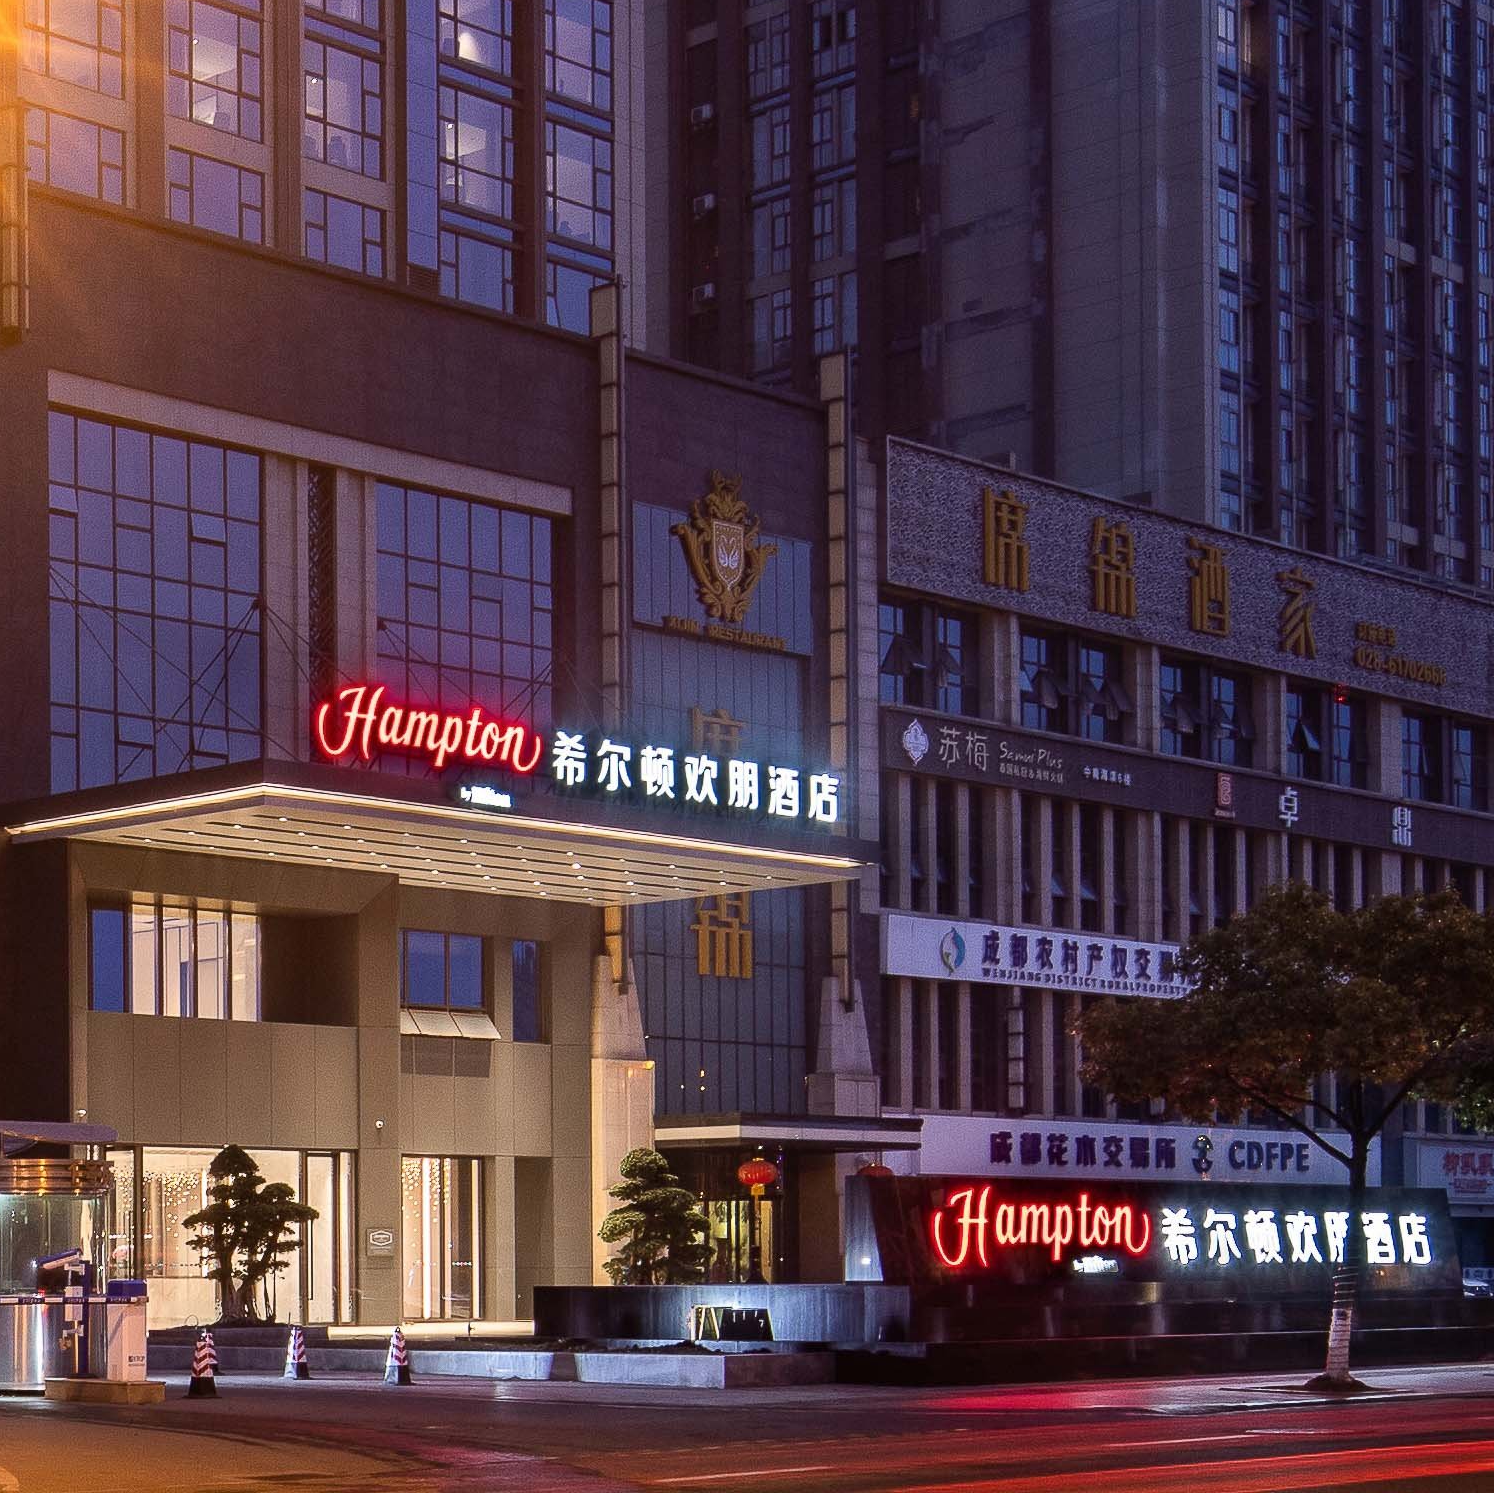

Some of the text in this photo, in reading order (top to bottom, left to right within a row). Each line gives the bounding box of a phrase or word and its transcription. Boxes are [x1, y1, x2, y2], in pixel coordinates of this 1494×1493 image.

[707, 624, 785, 651] RESTAURANT
[317, 686, 541, 774] Hampton
[938, 726, 989, 773] 苏梅
[1037, 748, 1063, 769] Plus
[551, 731, 841, 824] 希尔顿欢朋酒店
[982, 967, 1042, 982] WENJIANG
[1044, 973, 1097, 989] DISTRICT
[990, 1131, 1176, 1169] 成都花木交易所
[1228, 1139, 1310, 1172] CDFPE
[934, 1186, 1150, 1268] Hampton
